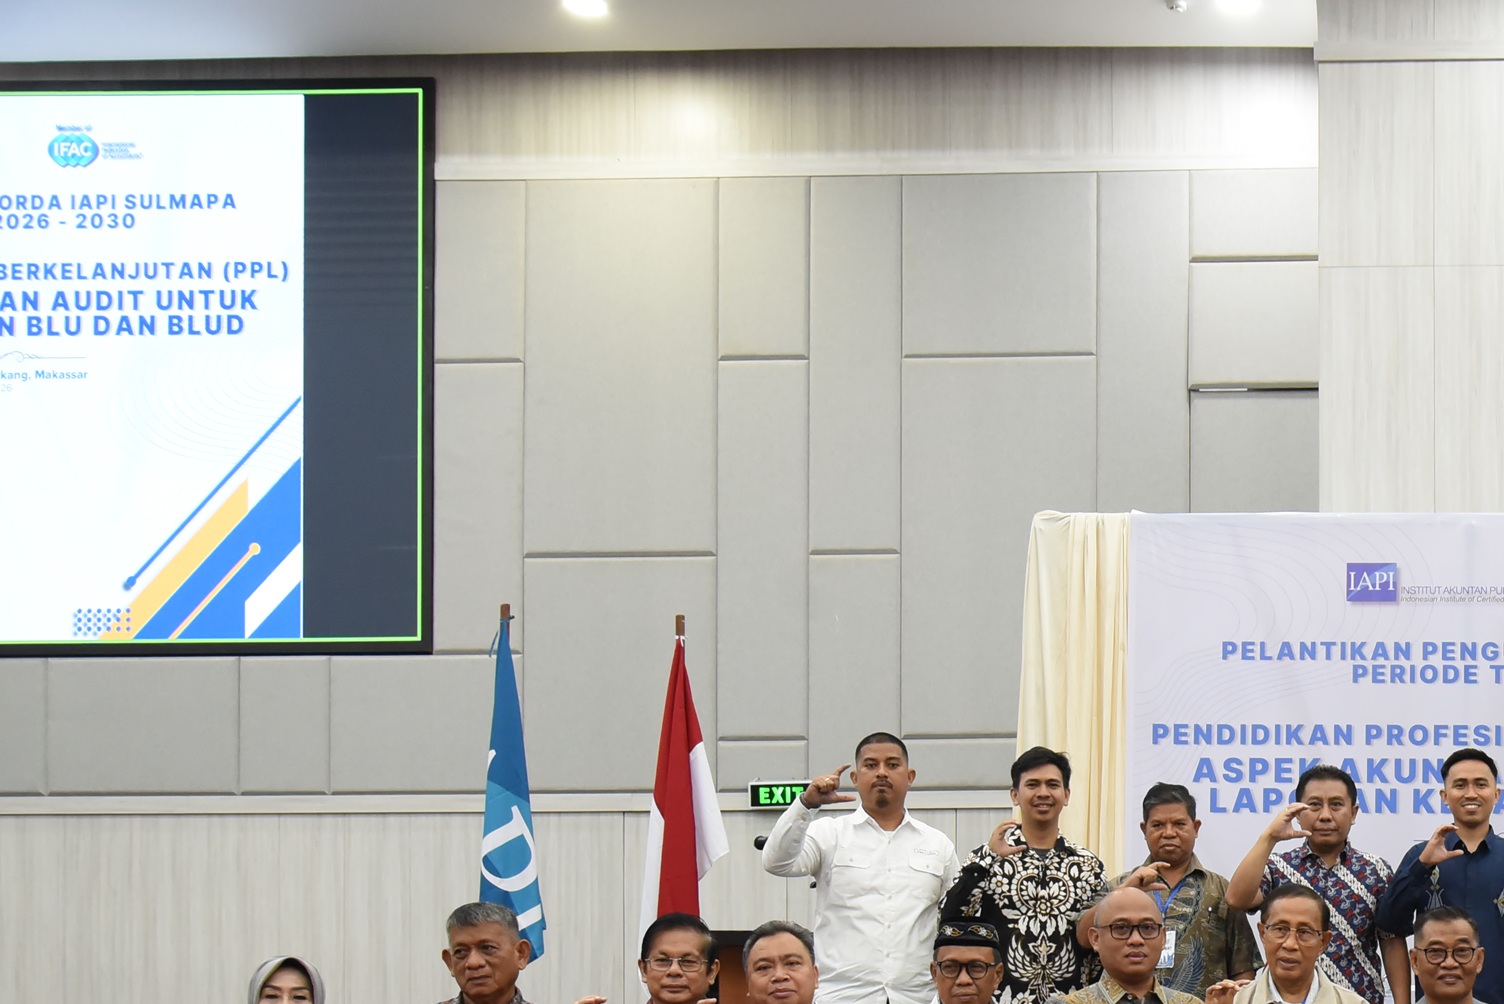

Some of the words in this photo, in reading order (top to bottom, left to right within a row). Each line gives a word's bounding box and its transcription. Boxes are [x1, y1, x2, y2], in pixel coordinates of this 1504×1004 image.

[53, 142, 92, 157] IFAC
[71, 194, 116, 210] IAPI
[124, 193, 236, 210] SULMAPA
[0, 213, 49, 229] 026
[76, 213, 136, 229] 2030
[0, 262, 212, 281] BERKELANJUTAN
[224, 261, 289, 282] (PPL)
[51, 290, 144, 312] AUDIT
[156, 289, 258, 311] UNTUK
[27, 316, 82, 336] BLU
[93, 315, 156, 336] DAN
[168, 314, 244, 336] BLUD
[35, 370, 88, 379] Makassar
[1348, 571, 1396, 591] IAPI
[1401, 586, 1441, 595] INSTITUT
[1443, 586, 1488, 595] AKUNTAN
[1401, 595, 1438, 603] Indonesian
[1440, 595, 1467, 603] Institute
[1477, 595, 1504, 603] Certified
[1222, 642, 1411, 661] PELANTIKAN
[1352, 664, 1478, 684] PERIODE
[1152, 724, 1353, 746] PENDIDIKAN
[759, 786, 804, 804] EXIT
[1210, 787, 1398, 814] LAPAN
